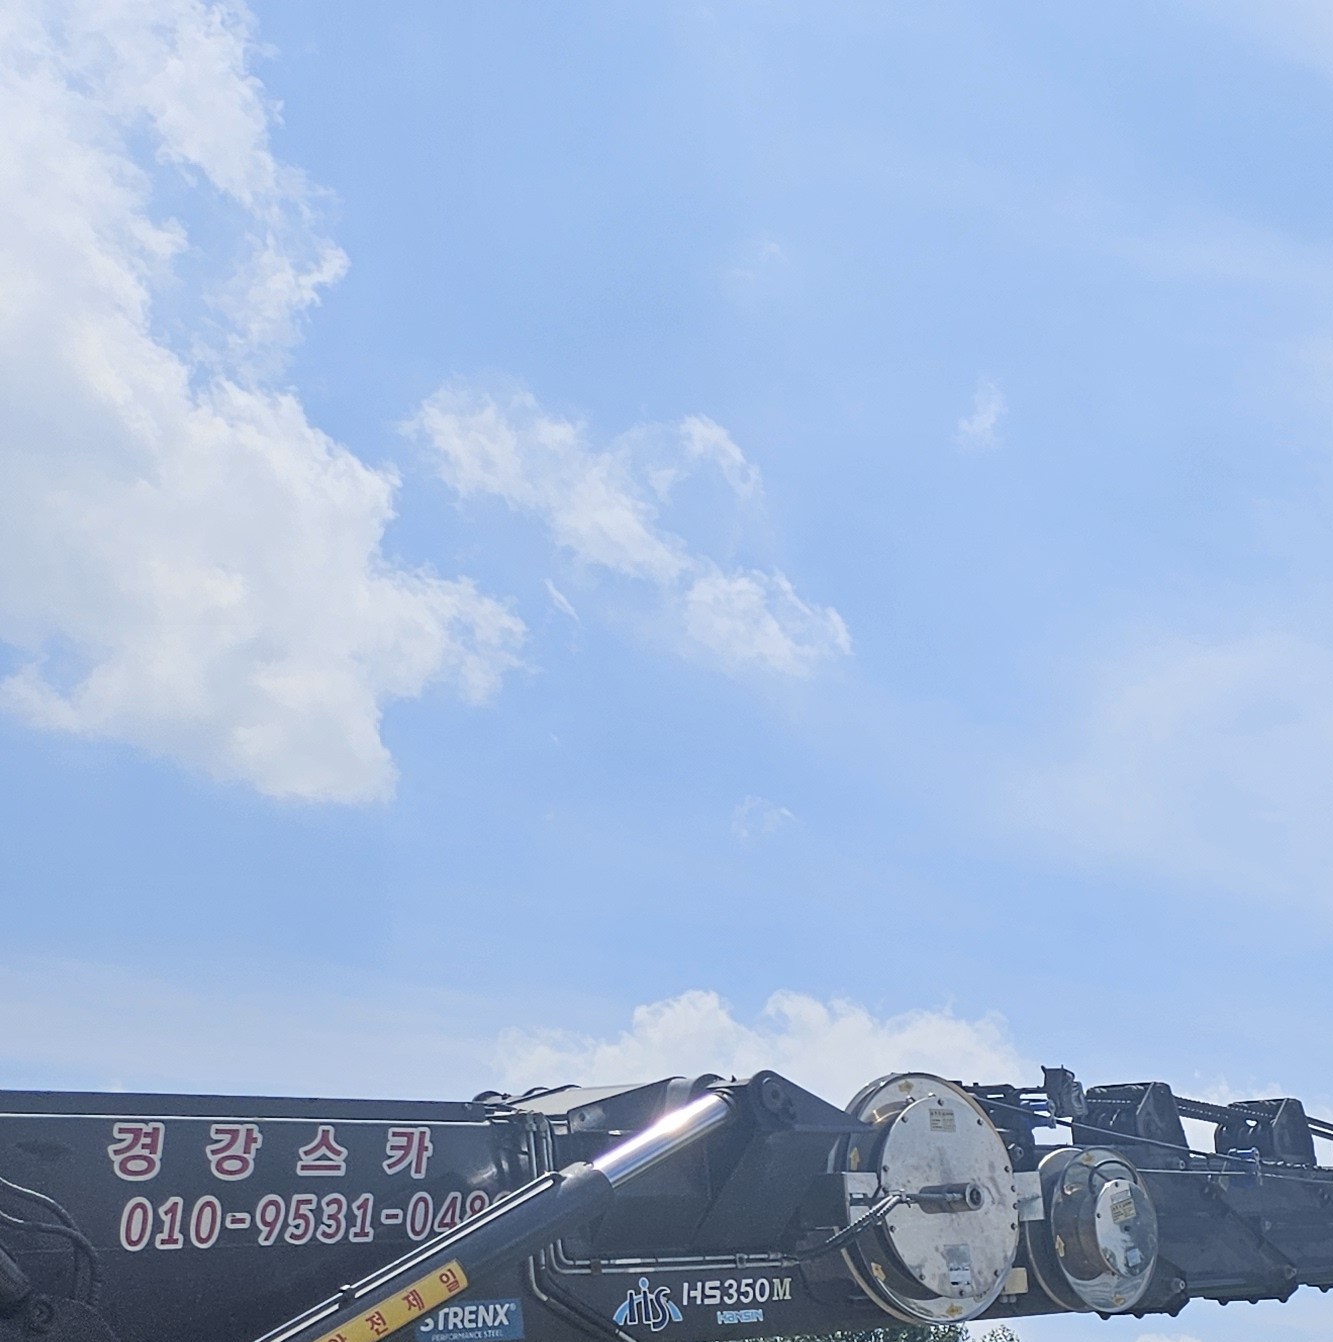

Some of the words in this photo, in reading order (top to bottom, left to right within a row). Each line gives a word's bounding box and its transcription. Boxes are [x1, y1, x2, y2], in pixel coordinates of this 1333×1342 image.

[108, 1122, 434, 1181] 경강스카
[120, 1190, 511, 1251] 010-9531-048
[431, 1331, 482, 1342] PERFORMANCE
[483, 1329, 503, 1339] STEEL
